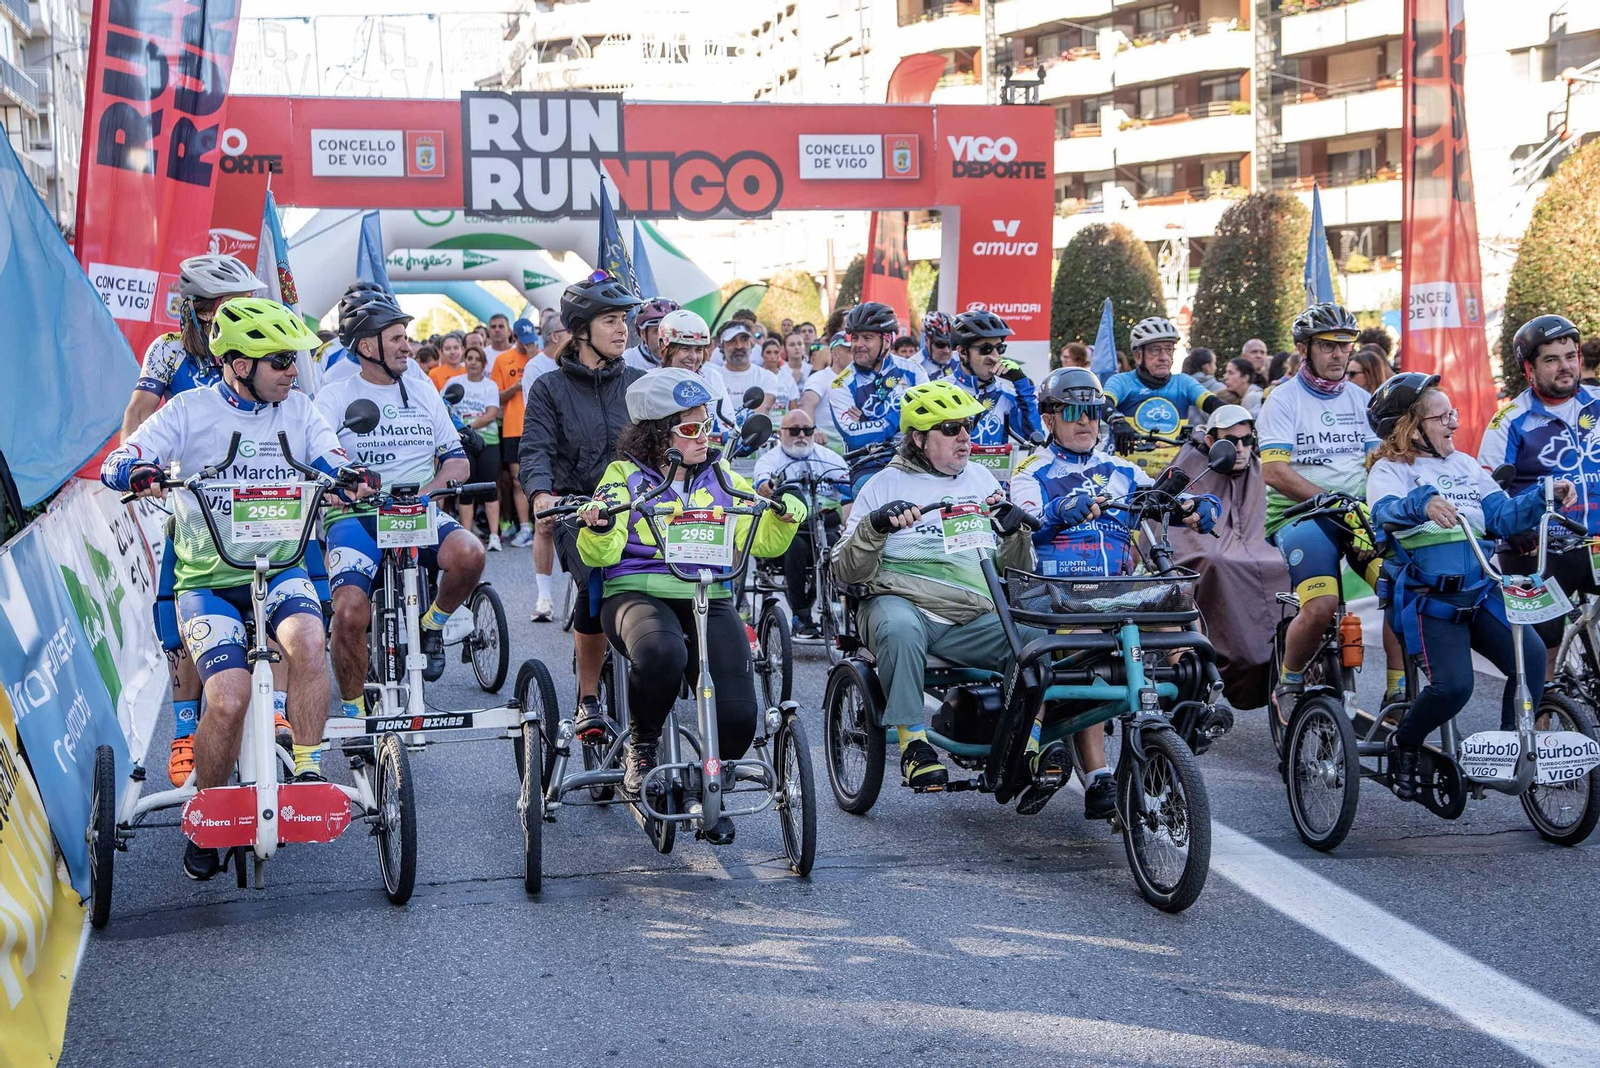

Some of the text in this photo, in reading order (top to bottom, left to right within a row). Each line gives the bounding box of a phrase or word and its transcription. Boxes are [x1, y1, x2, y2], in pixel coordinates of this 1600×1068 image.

[469, 97, 619, 153] RUN
[318, 139, 396, 152] CONCELLO
[806, 144, 875, 155] CONCELLO
[947, 136, 1018, 162] VIGO
[220, 154, 283, 174] ORTE
[328, 153, 388, 166] DE VIGO
[814, 158, 867, 169] DE VIGO
[952, 161, 1047, 180] DEPORTE
[972, 241, 1039, 256] amura
[95, 275, 156, 294] CONCELLO
[117, 295, 150, 310] VIGO
[989, 303, 1041, 313] HYUNDAI
[380, 424, 433, 436] Marcha
[356, 439, 386, 448] contra
[387, 439, 397, 447] el
[398, 438, 427, 446] cáncer
[1296, 430, 1366, 445] En Marcha
[1297, 447, 1324, 456] contra
[232, 464, 296, 480] Marcha
[205, 495, 231, 515] Vig
[248, 505, 288, 518] 2956
[390, 519, 417, 529] 2951
[954, 519, 984, 533] 2960
[680, 528, 715, 542] 2958
[1509, 599, 1543, 610] 3562
[1464, 742, 1519, 757] turbo10
[1537, 741, 1599, 760] turbo10
[1471, 767, 1498, 777] VIGO
[1548, 767, 1585, 781] VIGO
[201, 818, 231, 827] ribera
[293, 813, 322, 822] ribera
